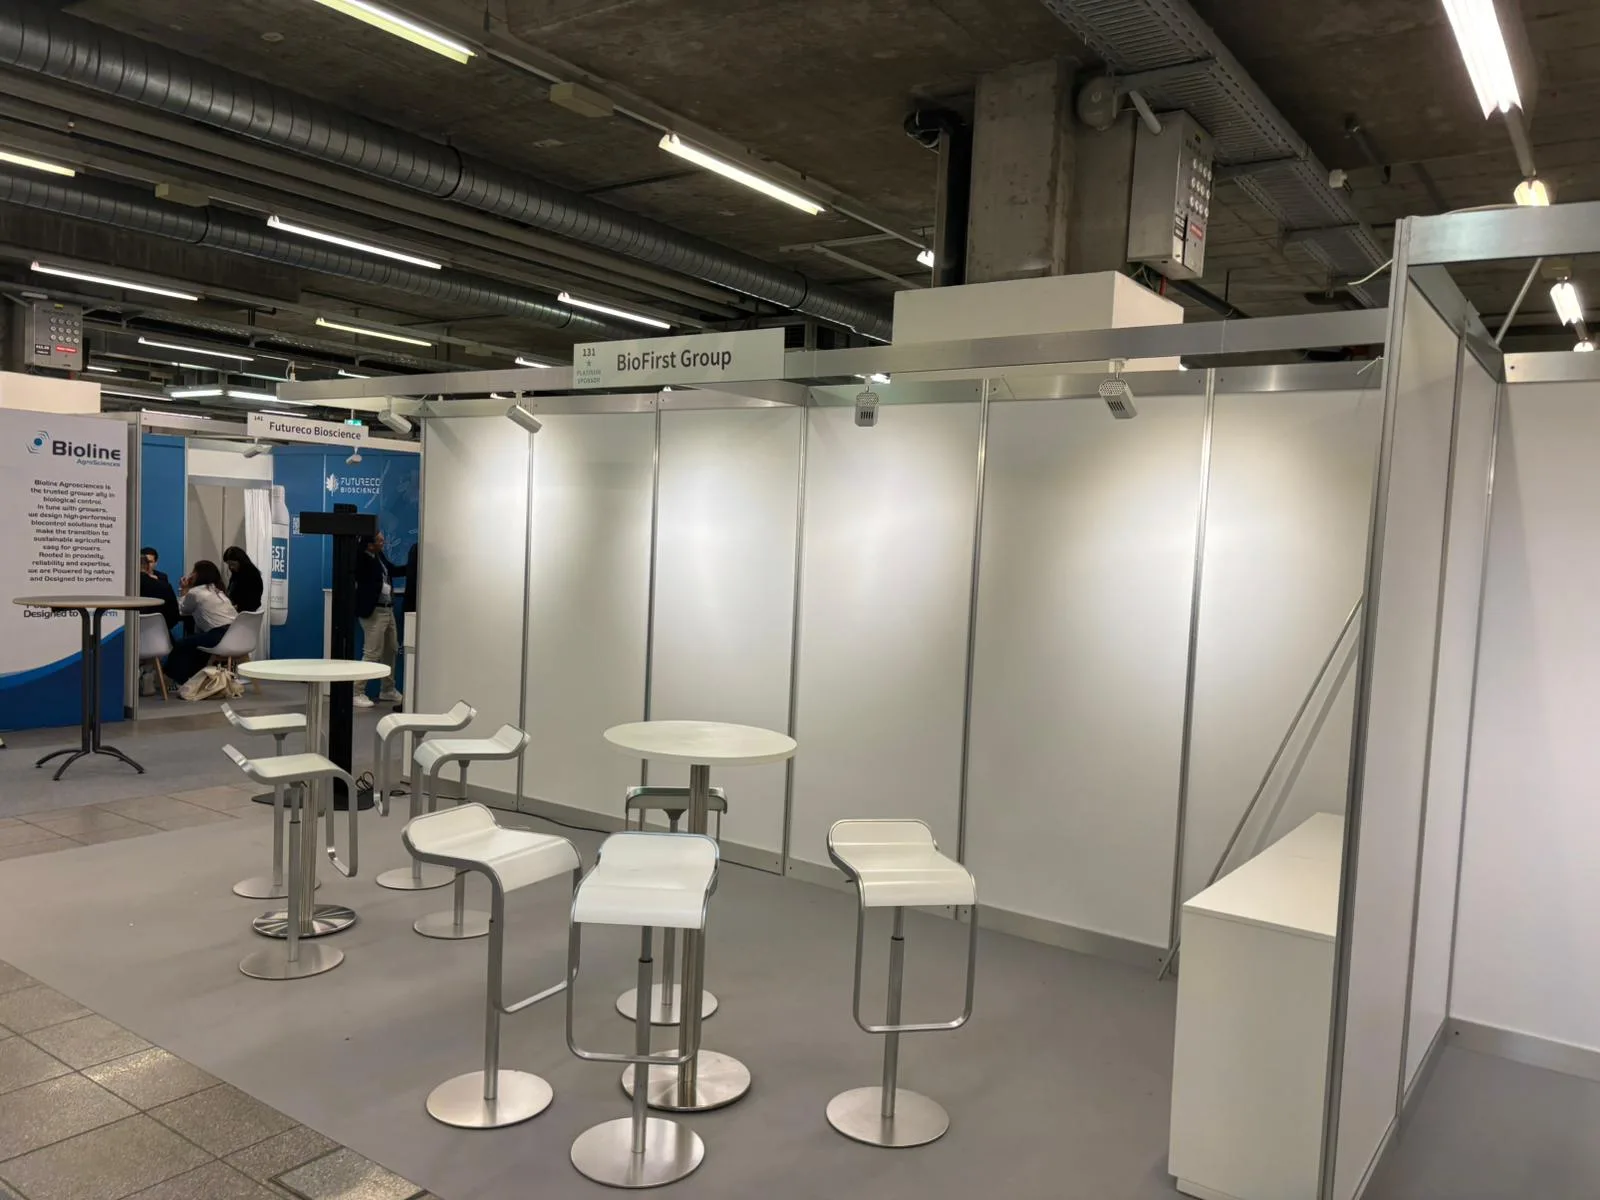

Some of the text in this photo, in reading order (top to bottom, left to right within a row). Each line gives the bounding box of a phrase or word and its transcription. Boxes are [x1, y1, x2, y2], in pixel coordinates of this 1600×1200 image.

[583, 348, 596, 356] 131
[616, 349, 732, 371] BioFirst Group
[269, 422, 361, 440] Futureco Bioscience
[52, 440, 120, 460] Bioline
[59, 481, 104, 490] Agrosciences
[340, 477, 380, 486] FUTURECO
